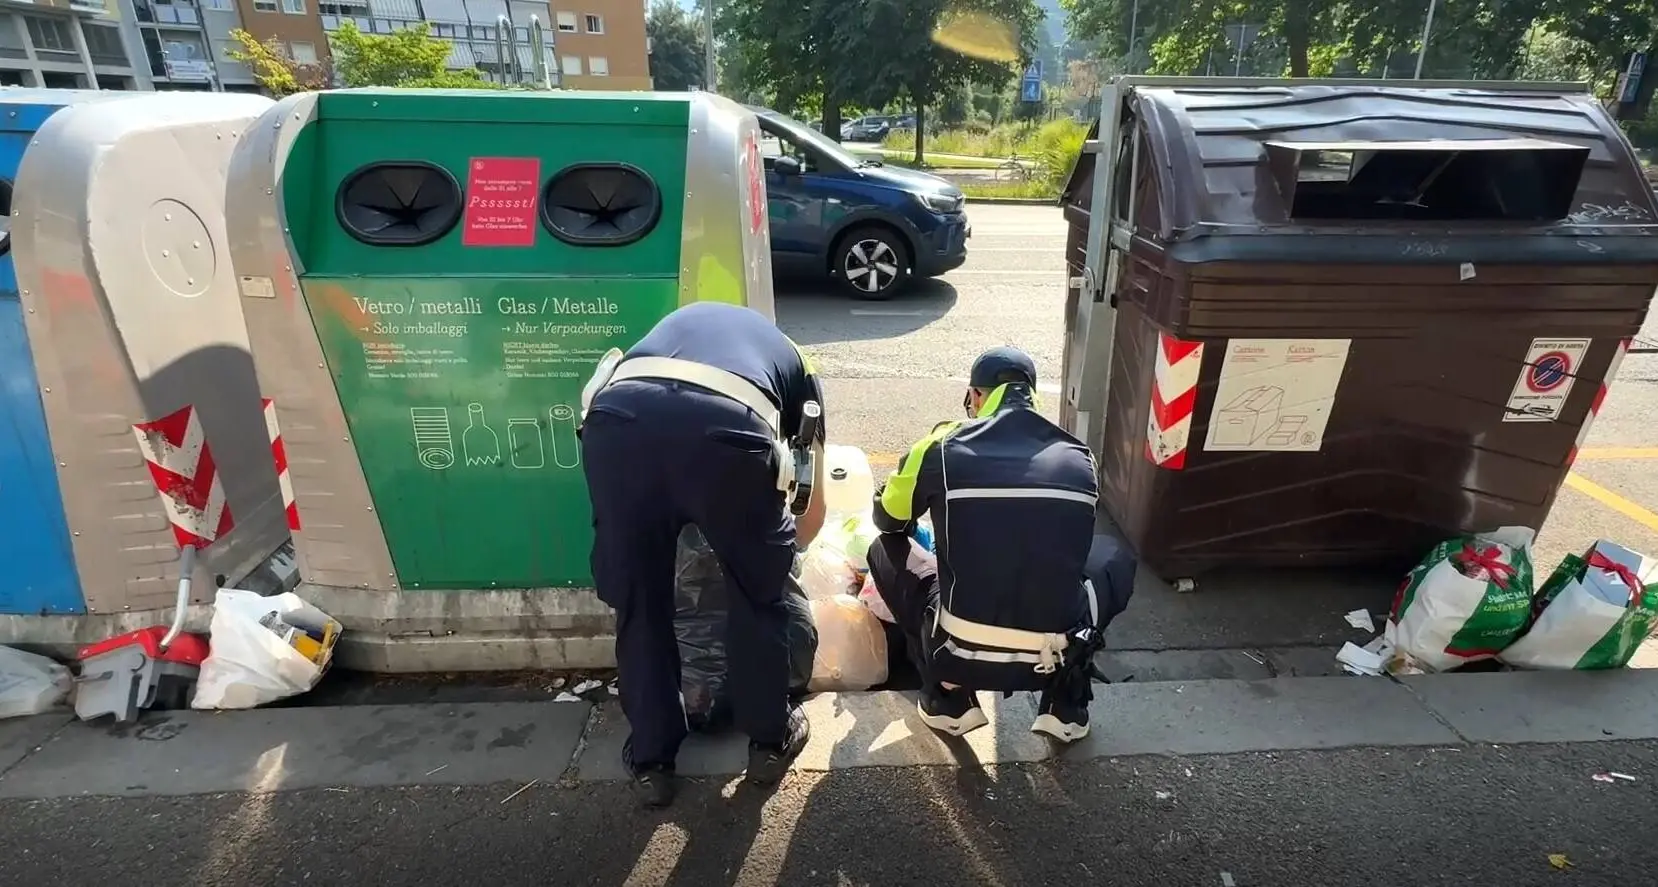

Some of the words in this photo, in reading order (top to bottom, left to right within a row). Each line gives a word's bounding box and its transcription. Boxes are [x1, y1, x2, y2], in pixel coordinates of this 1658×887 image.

[468, 195, 536, 208] Pssssst!
[352, 296, 404, 315] Vetro
[408, 296, 416, 315] /
[420, 296, 483, 315] metalli
[497, 296, 537, 315] Glas
[540, 296, 549, 315] /
[552, 296, 619, 315] Metalle
[373, 321, 400, 334] Solo
[403, 322, 469, 338] imballaggi
[514, 321, 539, 334] Nur
[542, 321, 627, 338] Verpackungen
